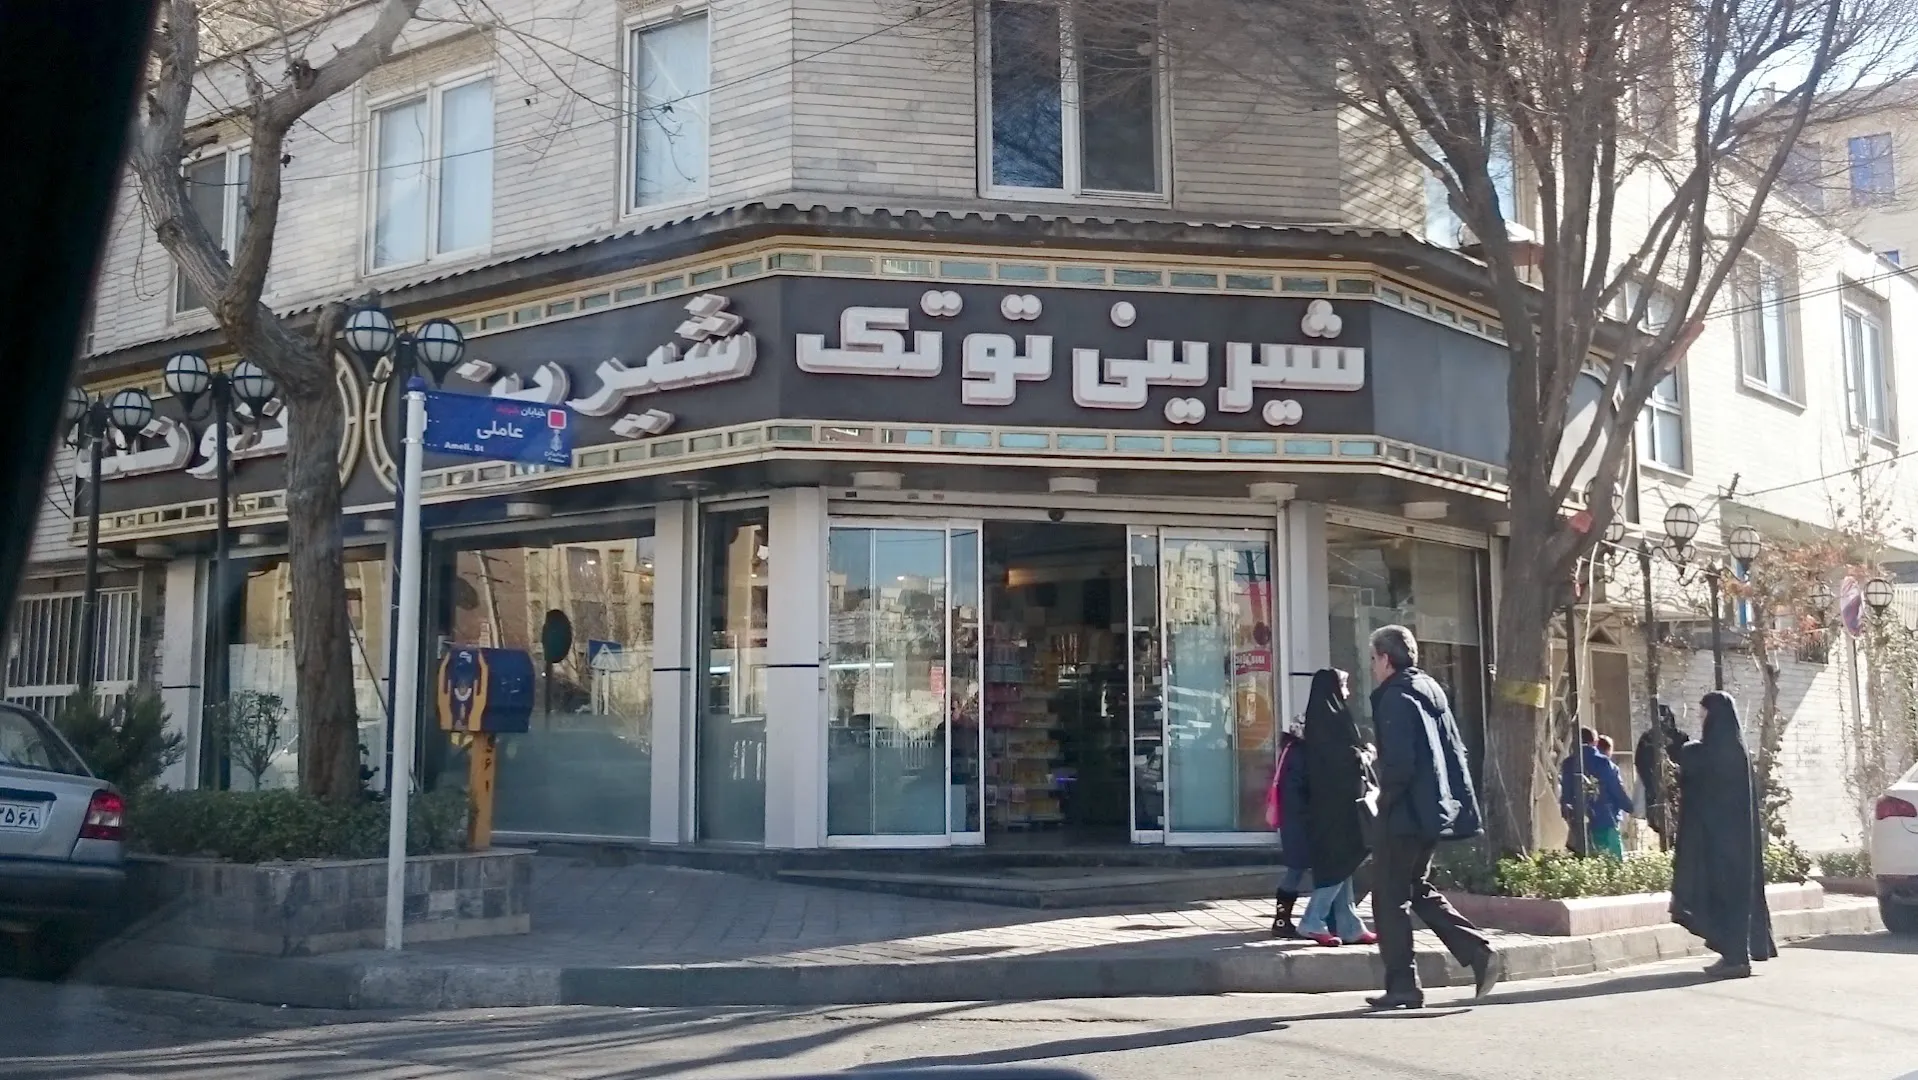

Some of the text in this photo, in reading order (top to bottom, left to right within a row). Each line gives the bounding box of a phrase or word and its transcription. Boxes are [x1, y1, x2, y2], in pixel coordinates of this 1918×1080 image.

[795, 289, 1365, 427] شیرینی توتک
[520, 406, 547, 419] خیابان
[476, 420, 524, 440] عاملی
